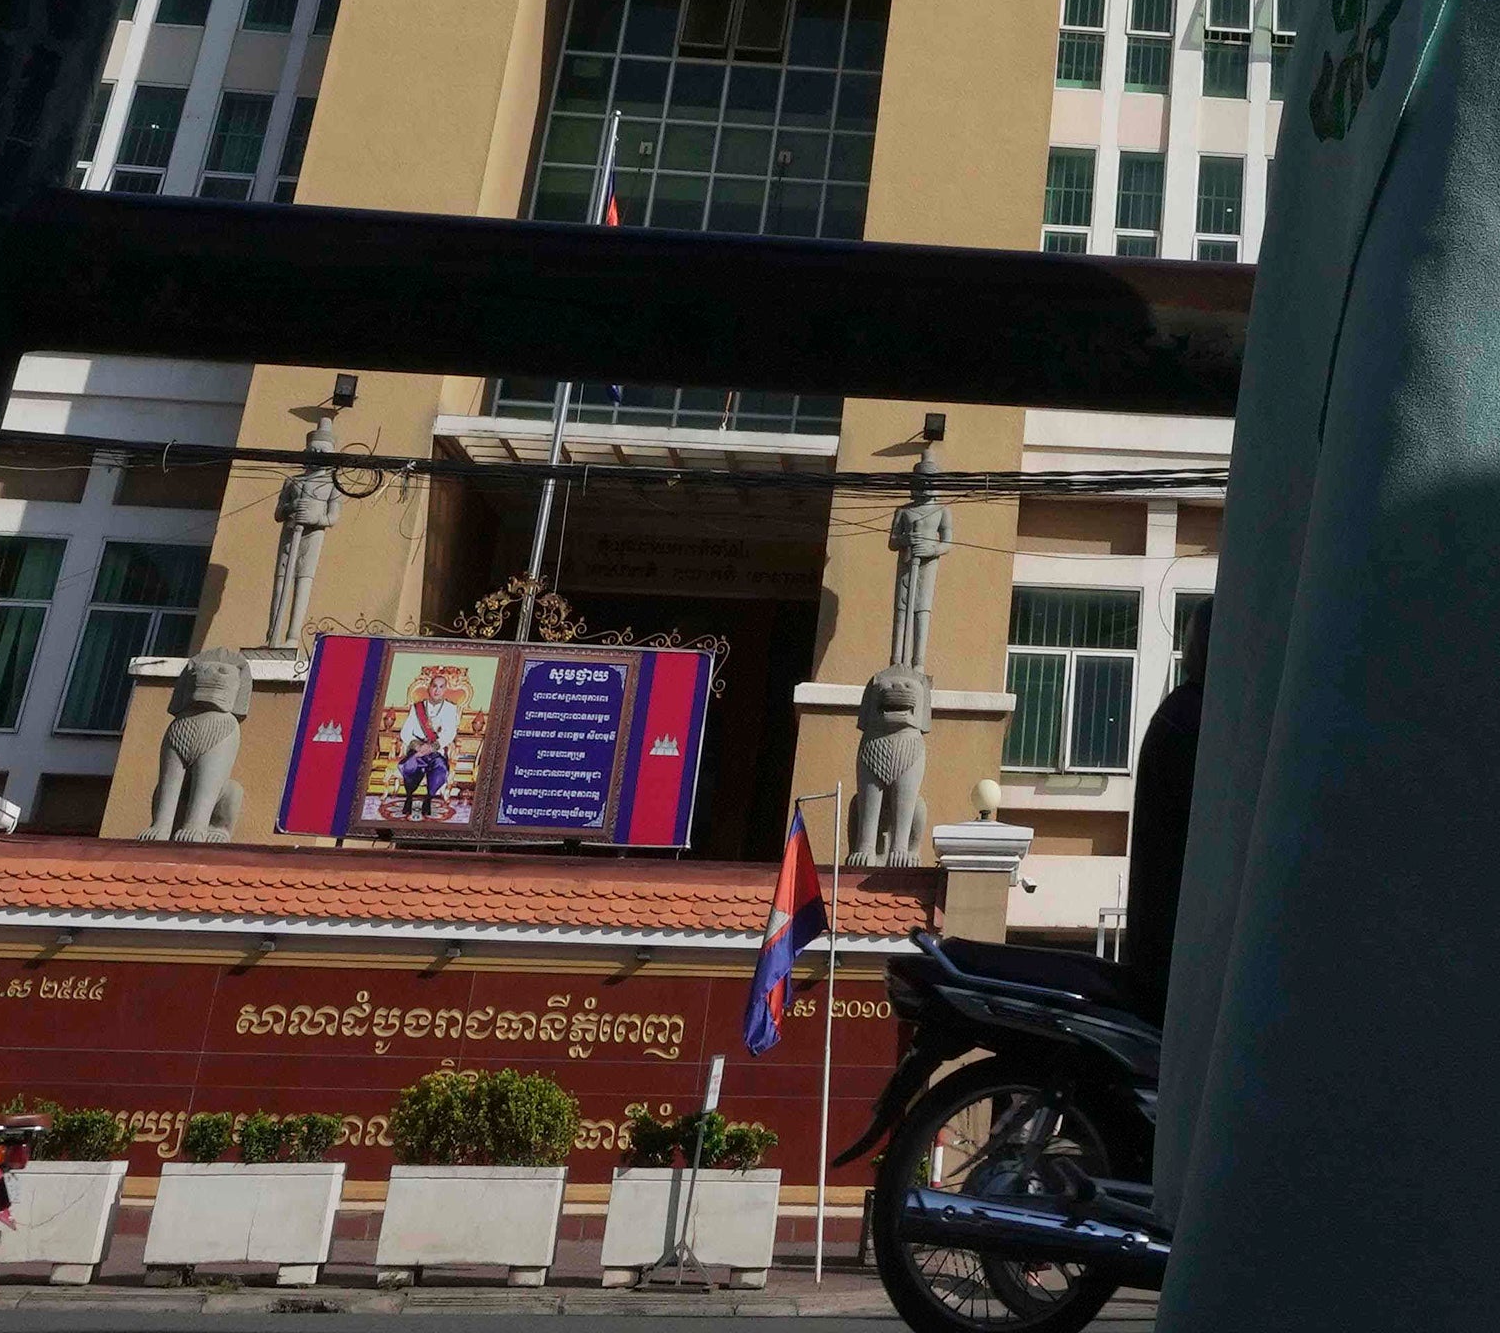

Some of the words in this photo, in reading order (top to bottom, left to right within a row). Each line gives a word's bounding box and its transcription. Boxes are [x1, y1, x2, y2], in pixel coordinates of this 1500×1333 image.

[549, 668, 609, 685] សូមថ្វាយ
[39, 976, 108, 1001] ២៥៥៤
[783, 997, 816, 1018] .ស
[236, 990, 686, 1060] សាលាដំបូងរាជធានីភ្នំពេញ
